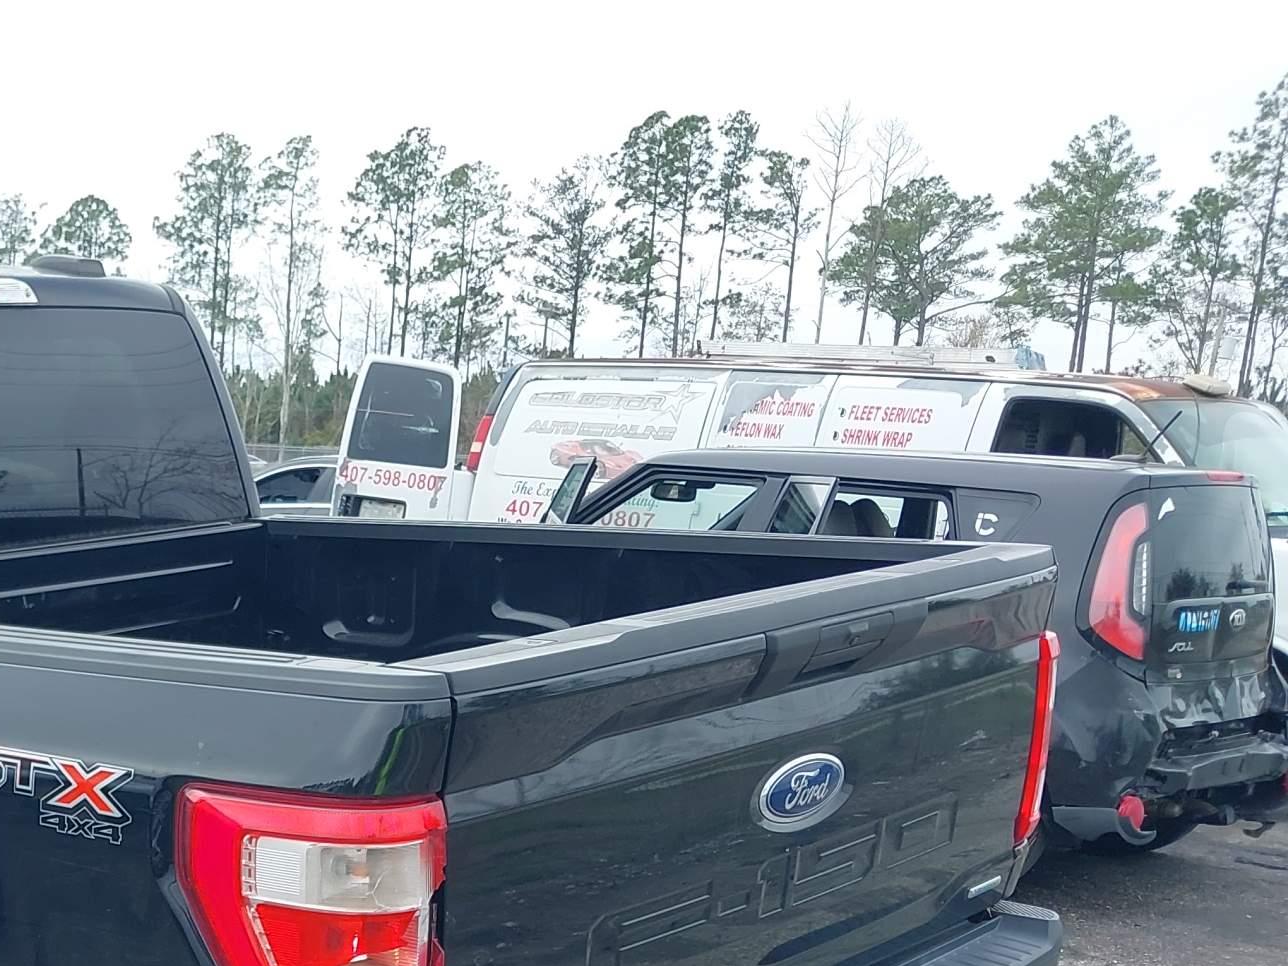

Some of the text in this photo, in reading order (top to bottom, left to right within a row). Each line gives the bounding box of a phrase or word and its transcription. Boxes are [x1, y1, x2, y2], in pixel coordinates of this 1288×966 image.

[776, 400, 816, 417] COATING
[848, 405, 934, 424] FLEET SERVICES
[524, 420, 578, 435] AUTO
[763, 424, 784, 439] WAX
[841, 429, 914, 448] SHRINK WRAP
[339, 464, 448, 491] 407-598-0807
[512, 480, 532, 496] The
[784, 768, 831, 811] Ford
